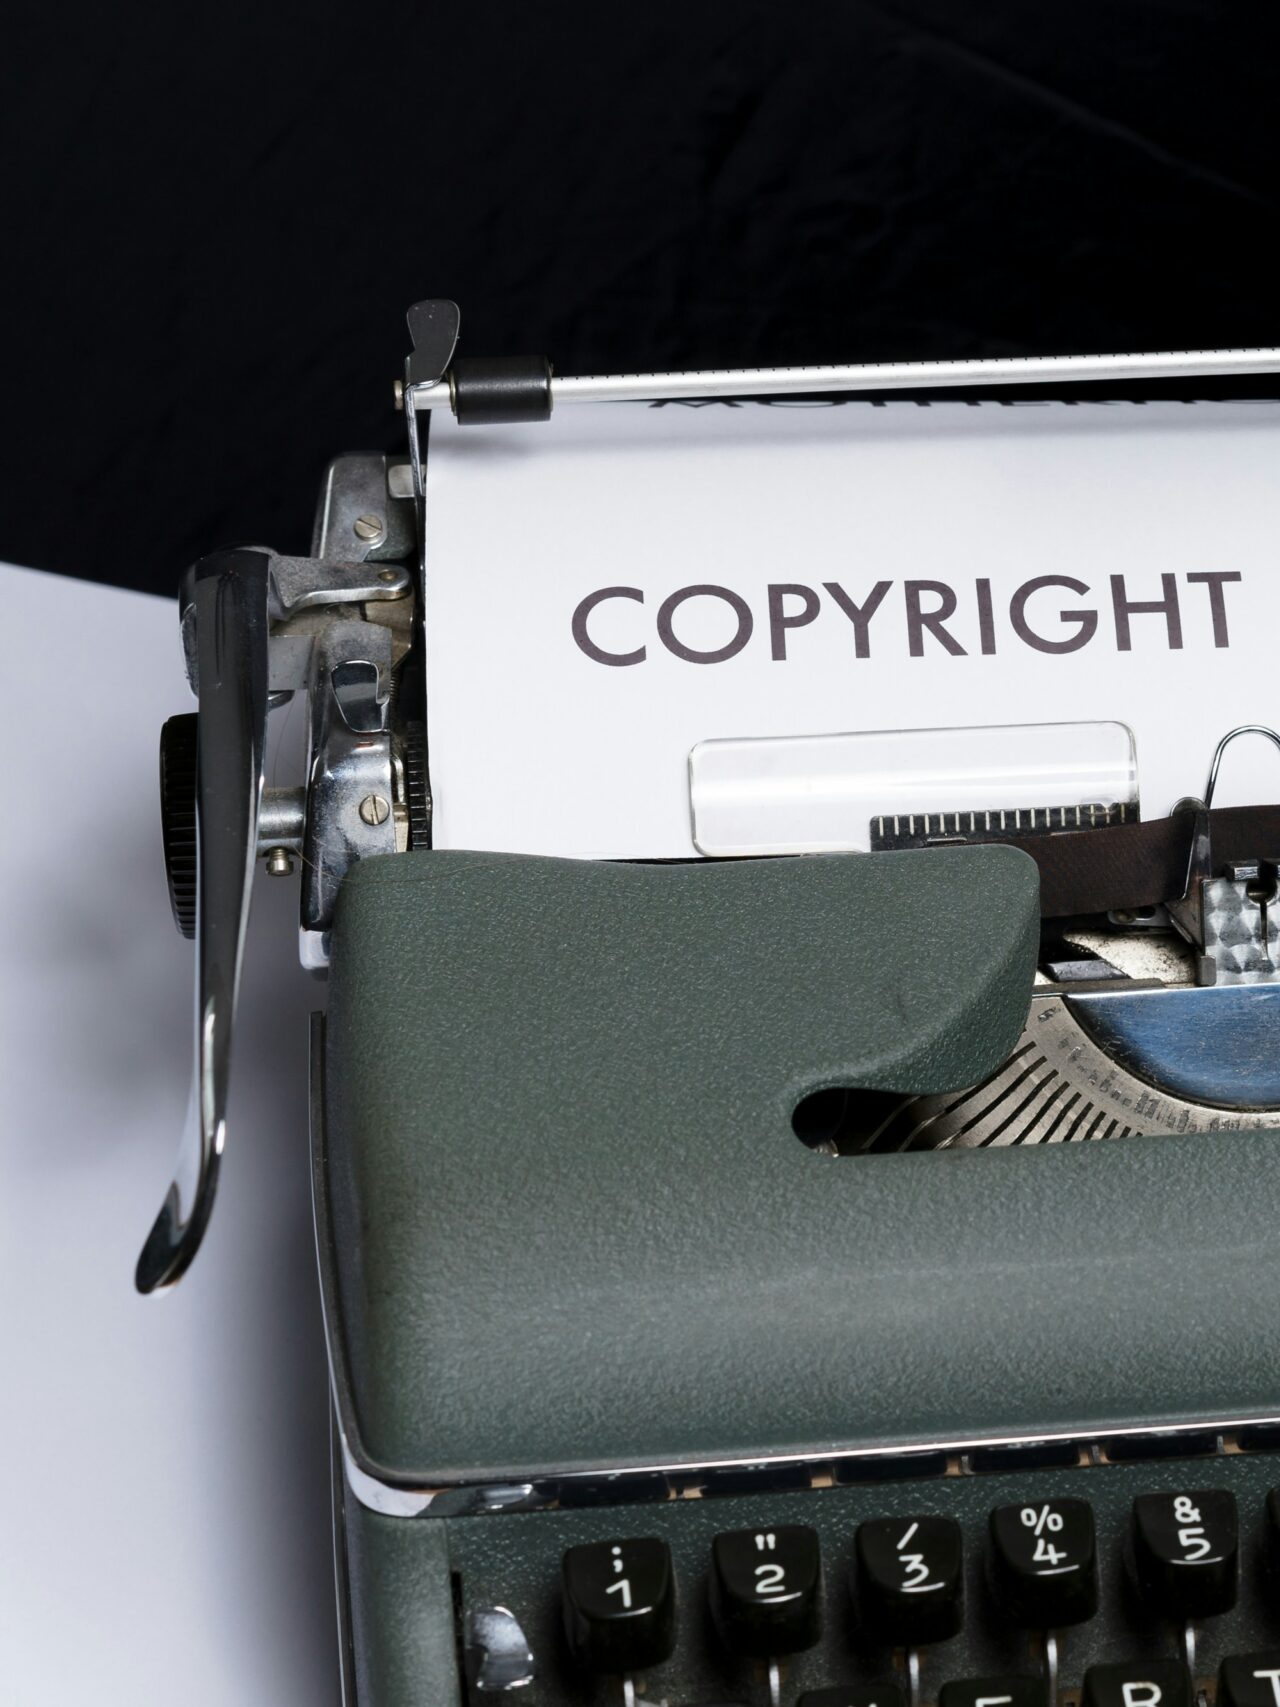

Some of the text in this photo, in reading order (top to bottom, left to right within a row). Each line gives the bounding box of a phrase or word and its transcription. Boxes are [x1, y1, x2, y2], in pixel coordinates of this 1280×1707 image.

[572, 572, 1241, 666] COPYRIGHT
[1021, 1505, 1063, 1535] %
[1174, 1496, 1201, 1523] &
[1033, 1539, 1066, 1564] 4
[1178, 1528, 1211, 1560] 5
[755, 1565, 784, 1593] 2
[899, 1554, 930, 1587] 3
[606, 1580, 631, 1607] 1
